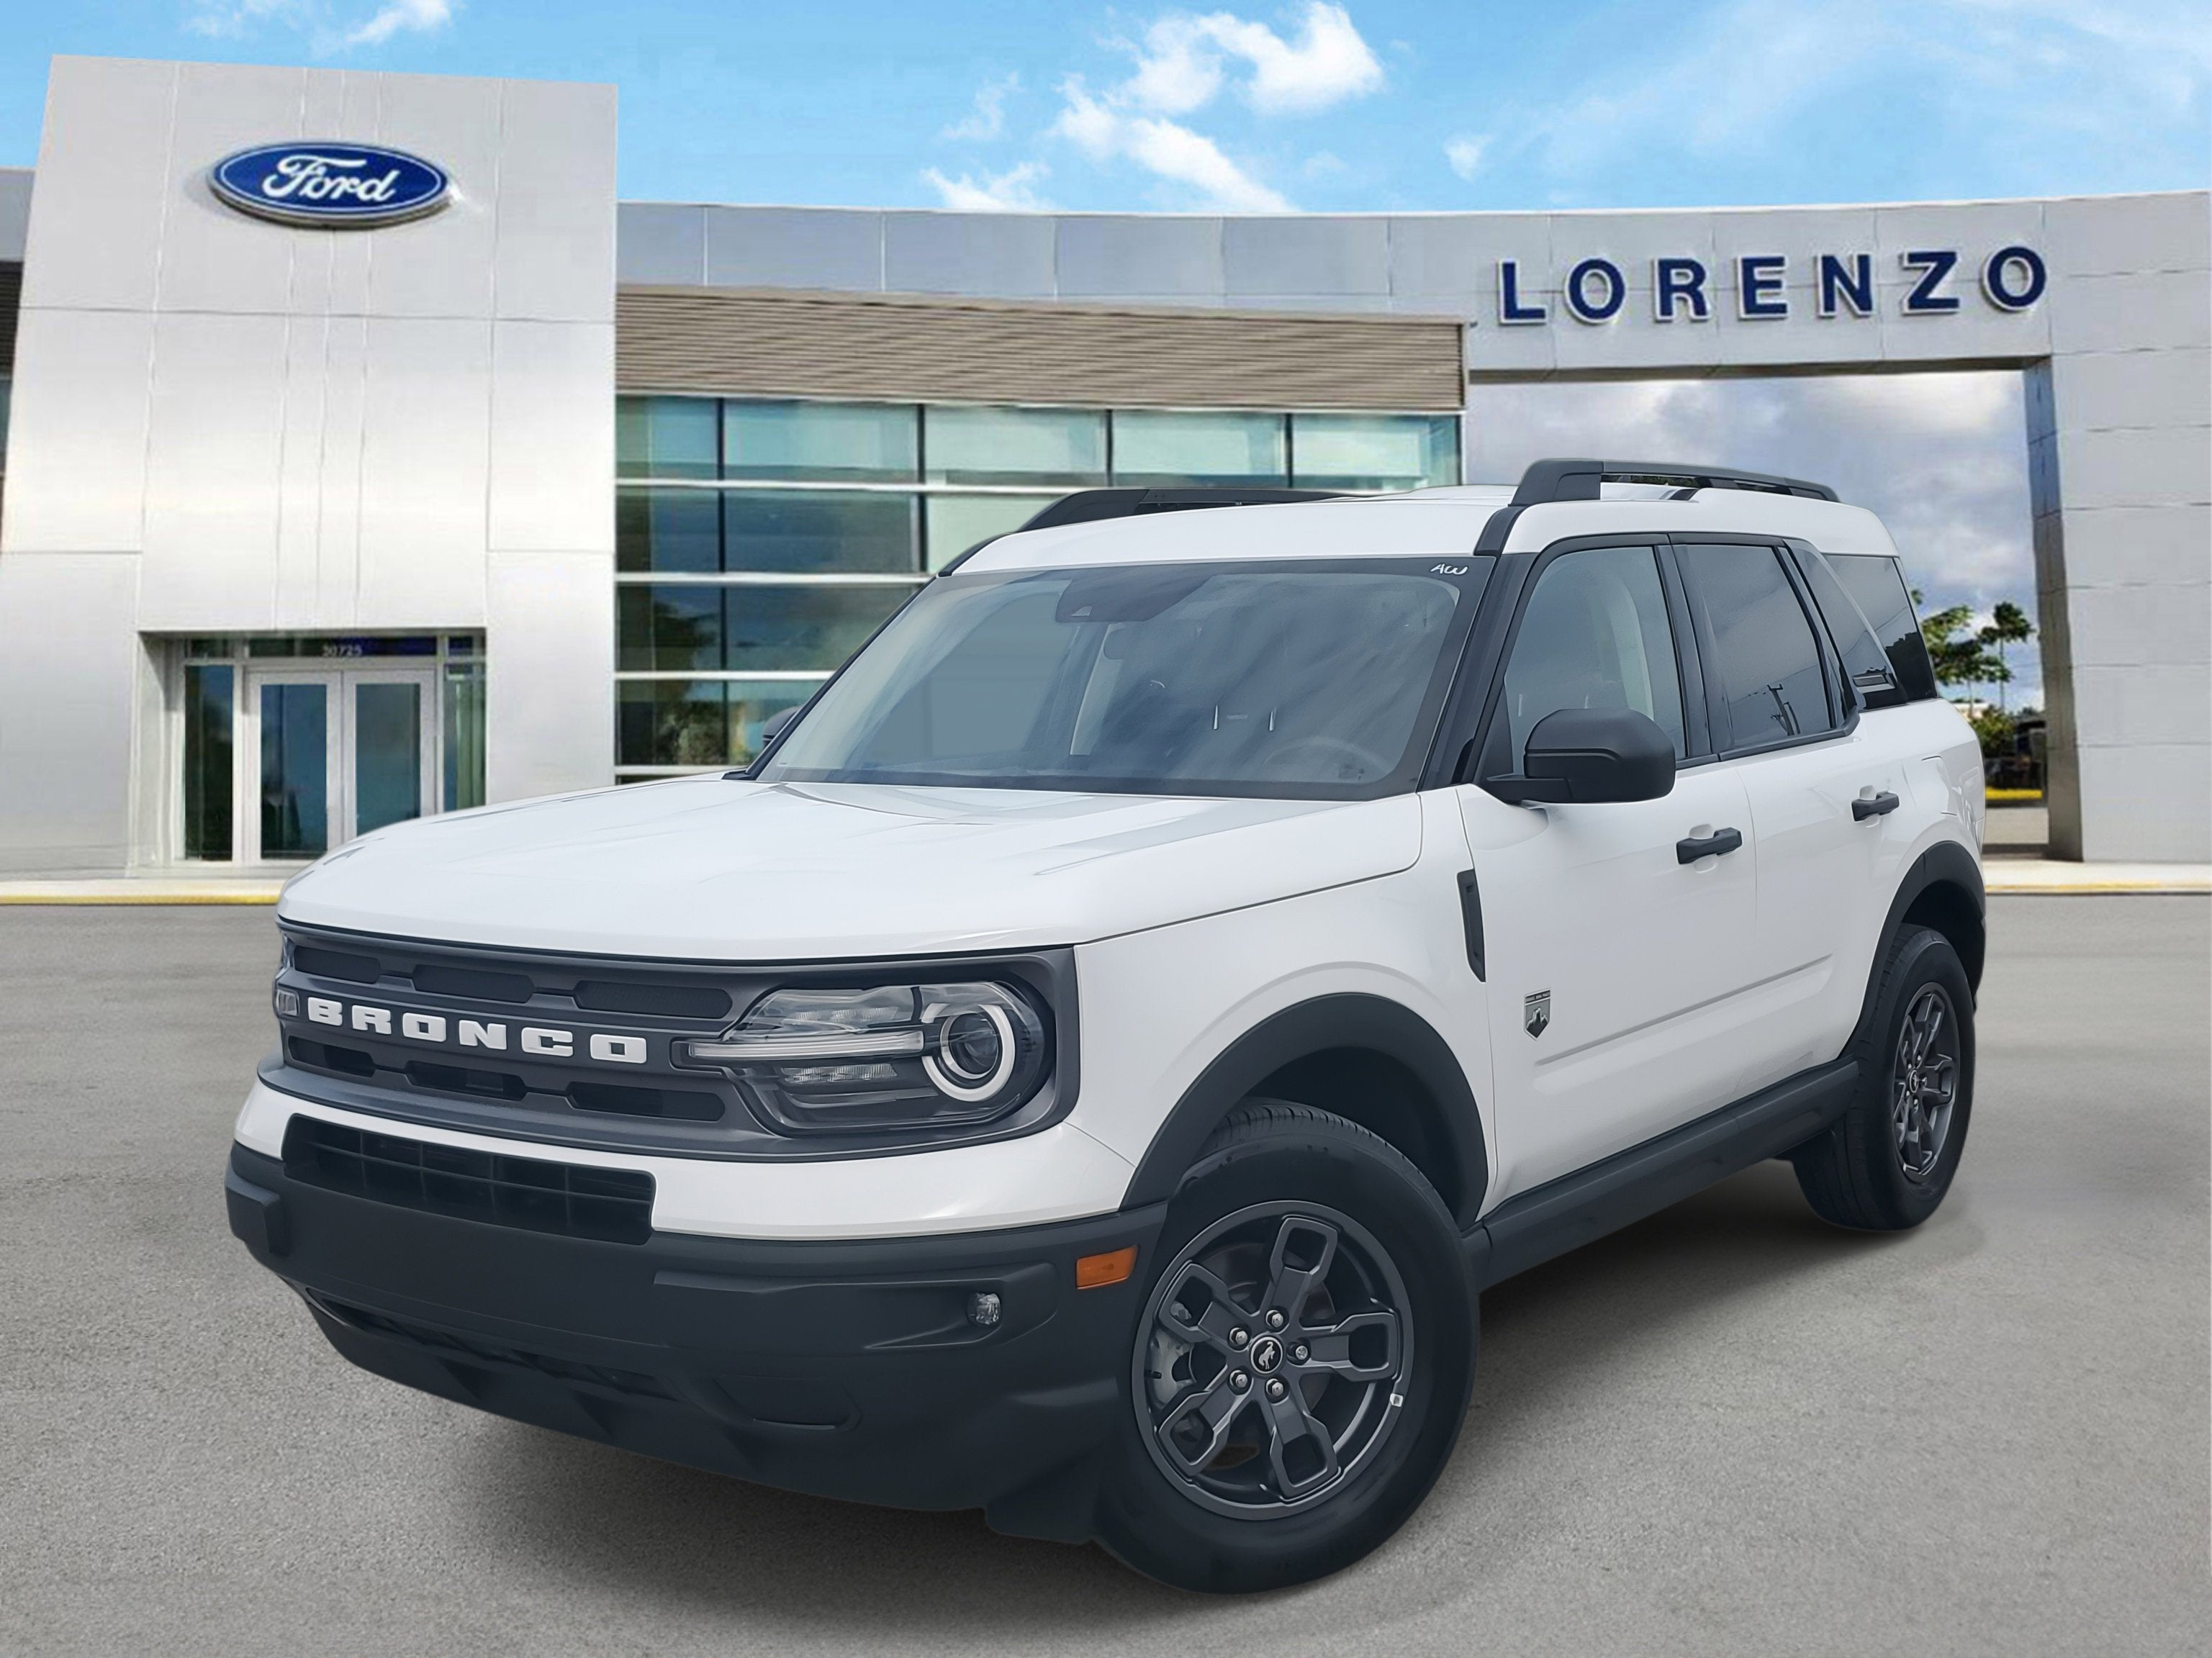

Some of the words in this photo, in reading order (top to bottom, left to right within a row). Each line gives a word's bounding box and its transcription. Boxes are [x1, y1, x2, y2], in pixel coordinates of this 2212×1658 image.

[262, 154, 400, 201] Ford
[1498, 245, 2047, 323] LORENZO
[307, 997, 647, 1064] BRONCO
